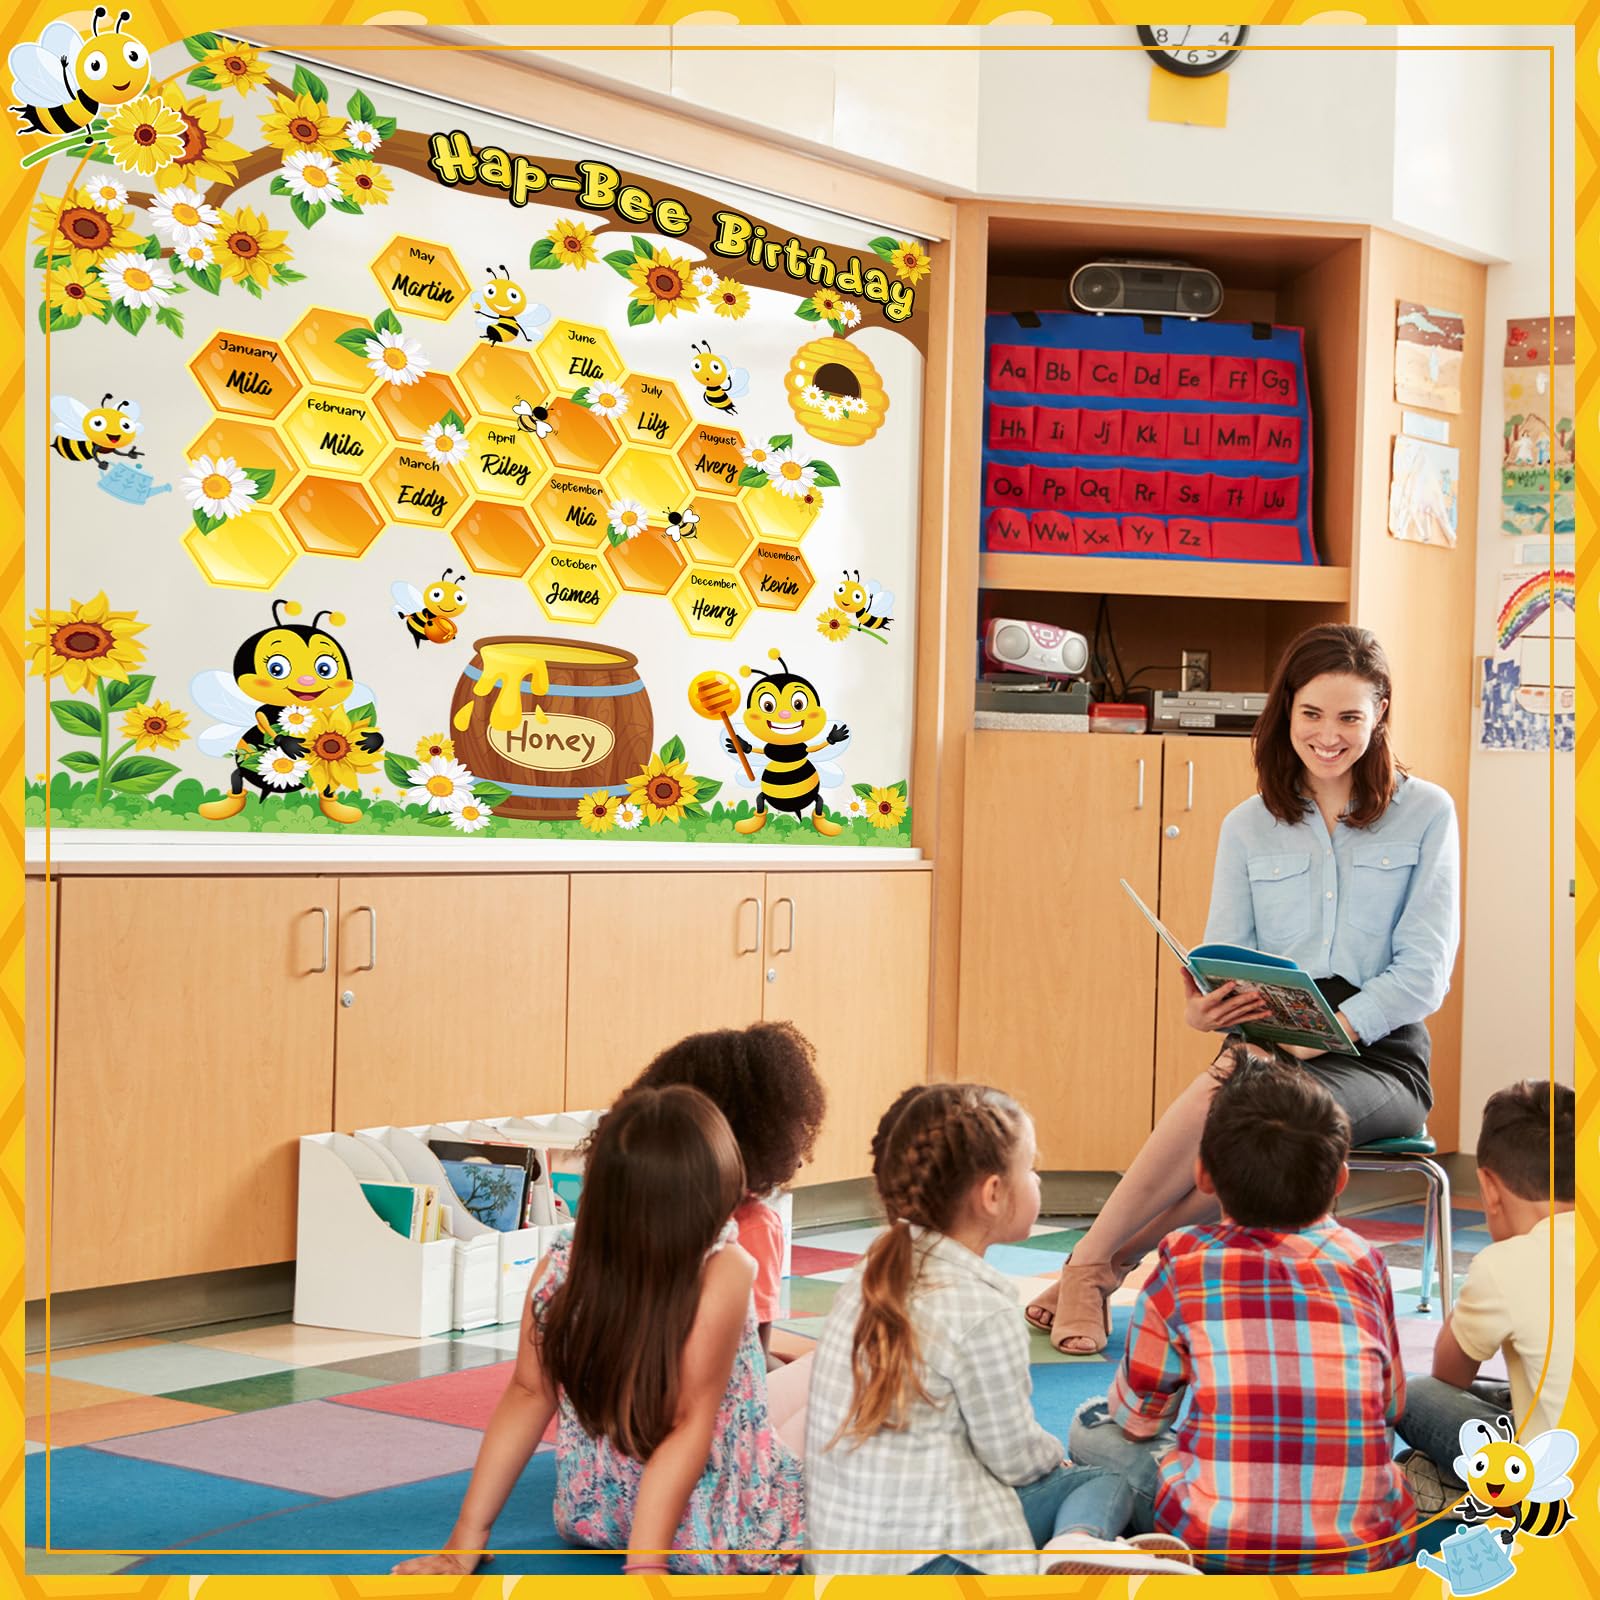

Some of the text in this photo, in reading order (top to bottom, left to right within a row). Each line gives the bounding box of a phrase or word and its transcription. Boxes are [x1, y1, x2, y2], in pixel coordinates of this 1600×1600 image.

[1156, 28, 1169, 43] 8
[1218, 31, 1230, 45] 4
[1187, 49, 1199, 63] 6
[428, 130, 915, 323] Hap-Bee Birthday
[409, 247, 435, 265] May
[391, 272, 454, 305] Martin
[568, 330, 597, 345] June
[219, 338, 278, 363] January
[569, 357, 604, 379] Ella
[1000, 359, 1289, 395] Aa Bb Cc Dd Ee Ff Gg
[225, 369, 273, 396] Mila
[641, 383, 663, 399] July
[307, 398, 367, 420] February
[637, 412, 669, 440] Lily
[1000, 420, 1292, 448] Hh Ii Jj Kk Ll Mm Nn
[320, 431, 364, 457] Mila
[488, 431, 516, 445] April
[699, 430, 737, 447] August
[399, 455, 440, 472] March
[480, 454, 531, 486] Riley
[695, 454, 738, 483] Avery
[550, 479, 603, 496] September
[993, 478, 1285, 508] Oo Pp Qq Rr Ss Tt Uu
[397, 484, 447, 517] Eddy
[565, 504, 597, 527] Mia
[1000, 521, 1201, 546] Vv Ww Xx Yy Zz
[551, 556, 597, 571] October
[758, 547, 801, 562] November
[691, 574, 737, 589] December
[760, 573, 799, 596] Kevin
[545, 582, 600, 605] James
[692, 597, 738, 627] Henry
[507, 720, 596, 763] Honey
